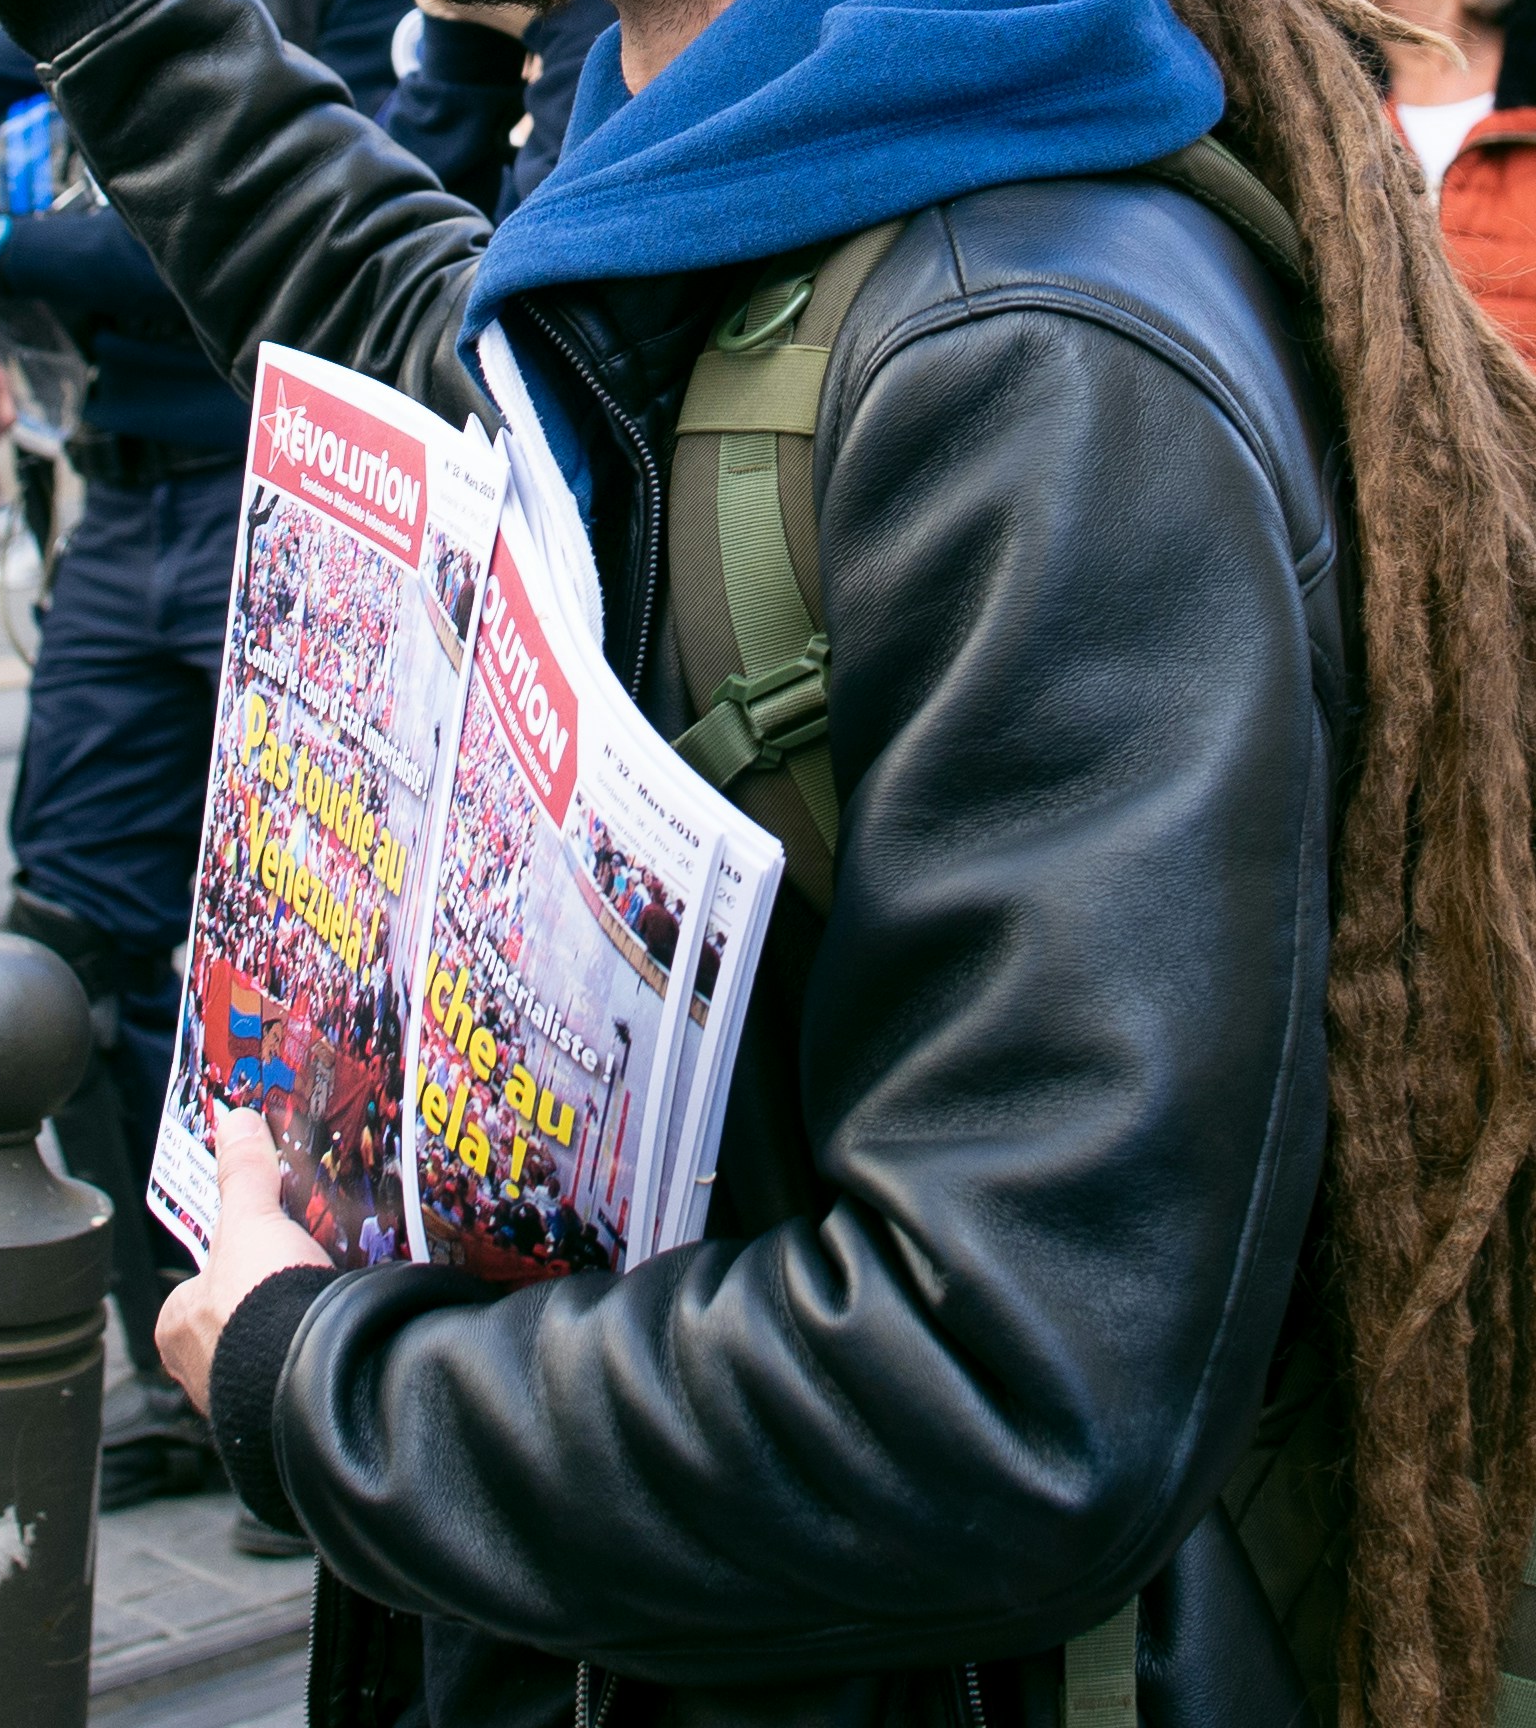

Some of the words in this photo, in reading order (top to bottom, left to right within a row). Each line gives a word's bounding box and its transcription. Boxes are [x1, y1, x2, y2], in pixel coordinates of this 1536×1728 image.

[364, 510, 413, 553] Internationale
[244, 629, 289, 684] Contre
[286, 655, 300, 693] le
[299, 680, 330, 720] coup
[482, 574, 569, 774] OLUTION
[242, 693, 292, 792] Pas
[294, 744, 376, 866] touche
[374, 826, 408, 898] au
[503, 701, 553, 798] Internationale
[637, 783, 665, 819] Mars
[668, 813, 701, 849] 2019
[249, 796, 362, 973] Venezuela
[473, 921, 599, 1074] impérialiste
[504, 1061, 577, 1148] au
